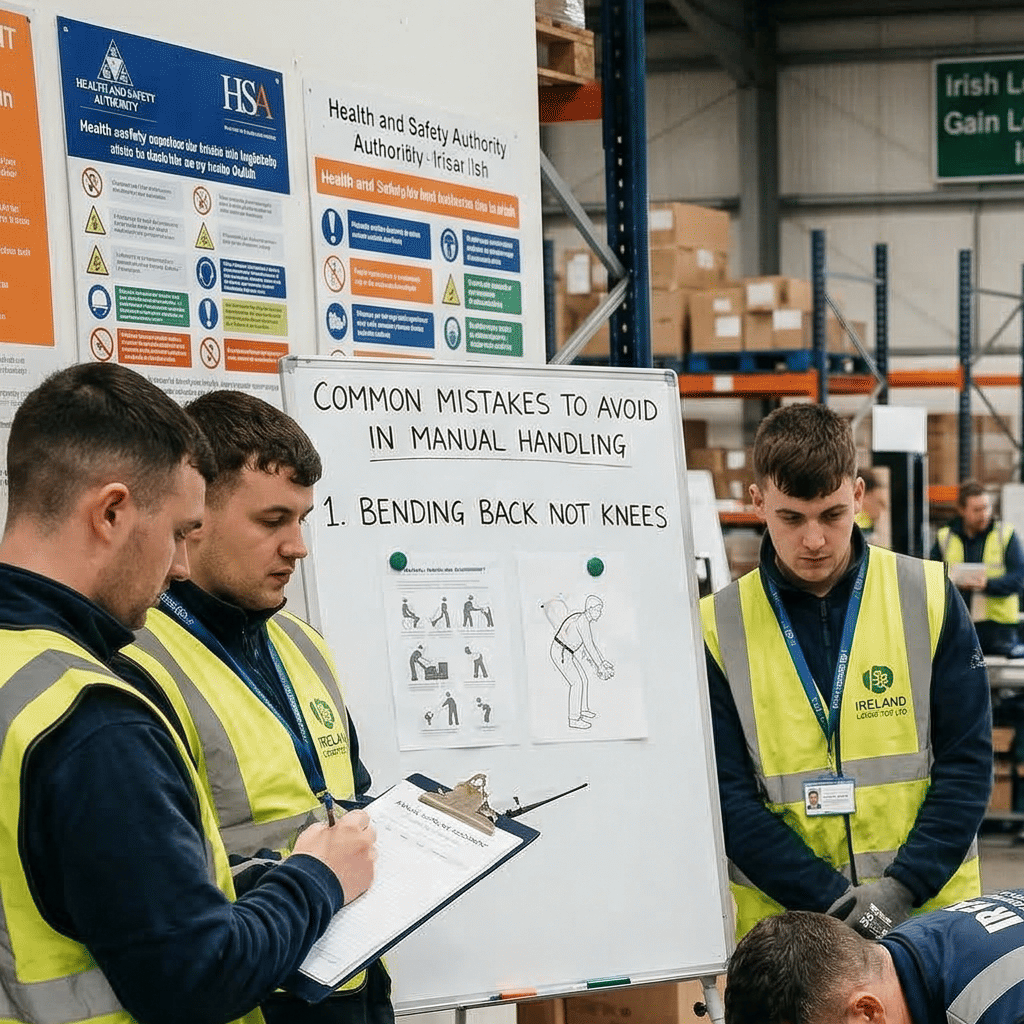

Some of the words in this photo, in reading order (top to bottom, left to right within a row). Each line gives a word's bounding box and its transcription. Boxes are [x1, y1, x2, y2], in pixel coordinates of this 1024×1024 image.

[221, 74, 273, 120] HSA
[945, 73, 999, 97] Irish
[328, 98, 375, 127] Health
[379, 114, 404, 133] and
[409, 116, 449, 147] Safety
[452, 127, 507, 160] Authority
[944, 110, 999, 136] Gain
[313, 380, 422, 414] COMMON
[437, 388, 550, 417] MISTAKES
[561, 393, 588, 418] TO
[597, 395, 659, 422] AVOID
[368, 425, 394, 451] IN
[411, 425, 507, 453] MANUAL
[518, 429, 627, 459] HANDLING
[323, 496, 346, 528] 1.
[359, 497, 465, 527] BENDING
[479, 498, 538, 526] BACK
[549, 501, 590, 527] NOT
[601, 502, 669, 530] KNEES
[855, 695, 907, 712] IRELAND
